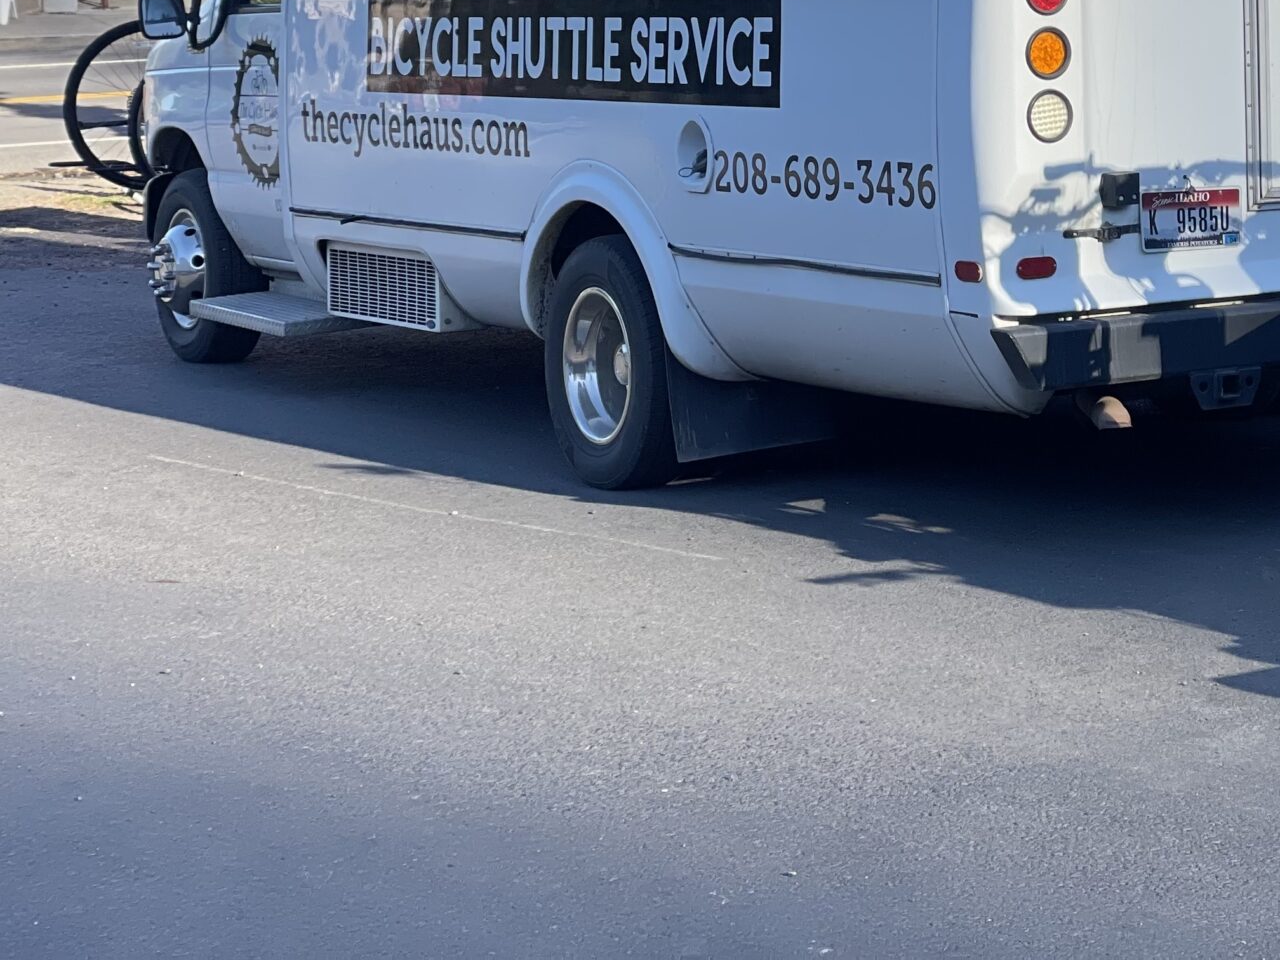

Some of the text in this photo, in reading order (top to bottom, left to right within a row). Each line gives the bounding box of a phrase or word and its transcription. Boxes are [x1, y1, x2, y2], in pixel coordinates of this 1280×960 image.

[370, 16, 773, 87] BICYCLE SHUTTLE SERVICE
[301, 99, 530, 158] thecyclehaus.com
[714, 150, 937, 209] 208-689-3436
[1175, 191, 1210, 203] IDAHO
[1149, 205, 1229, 235] K 9585U
